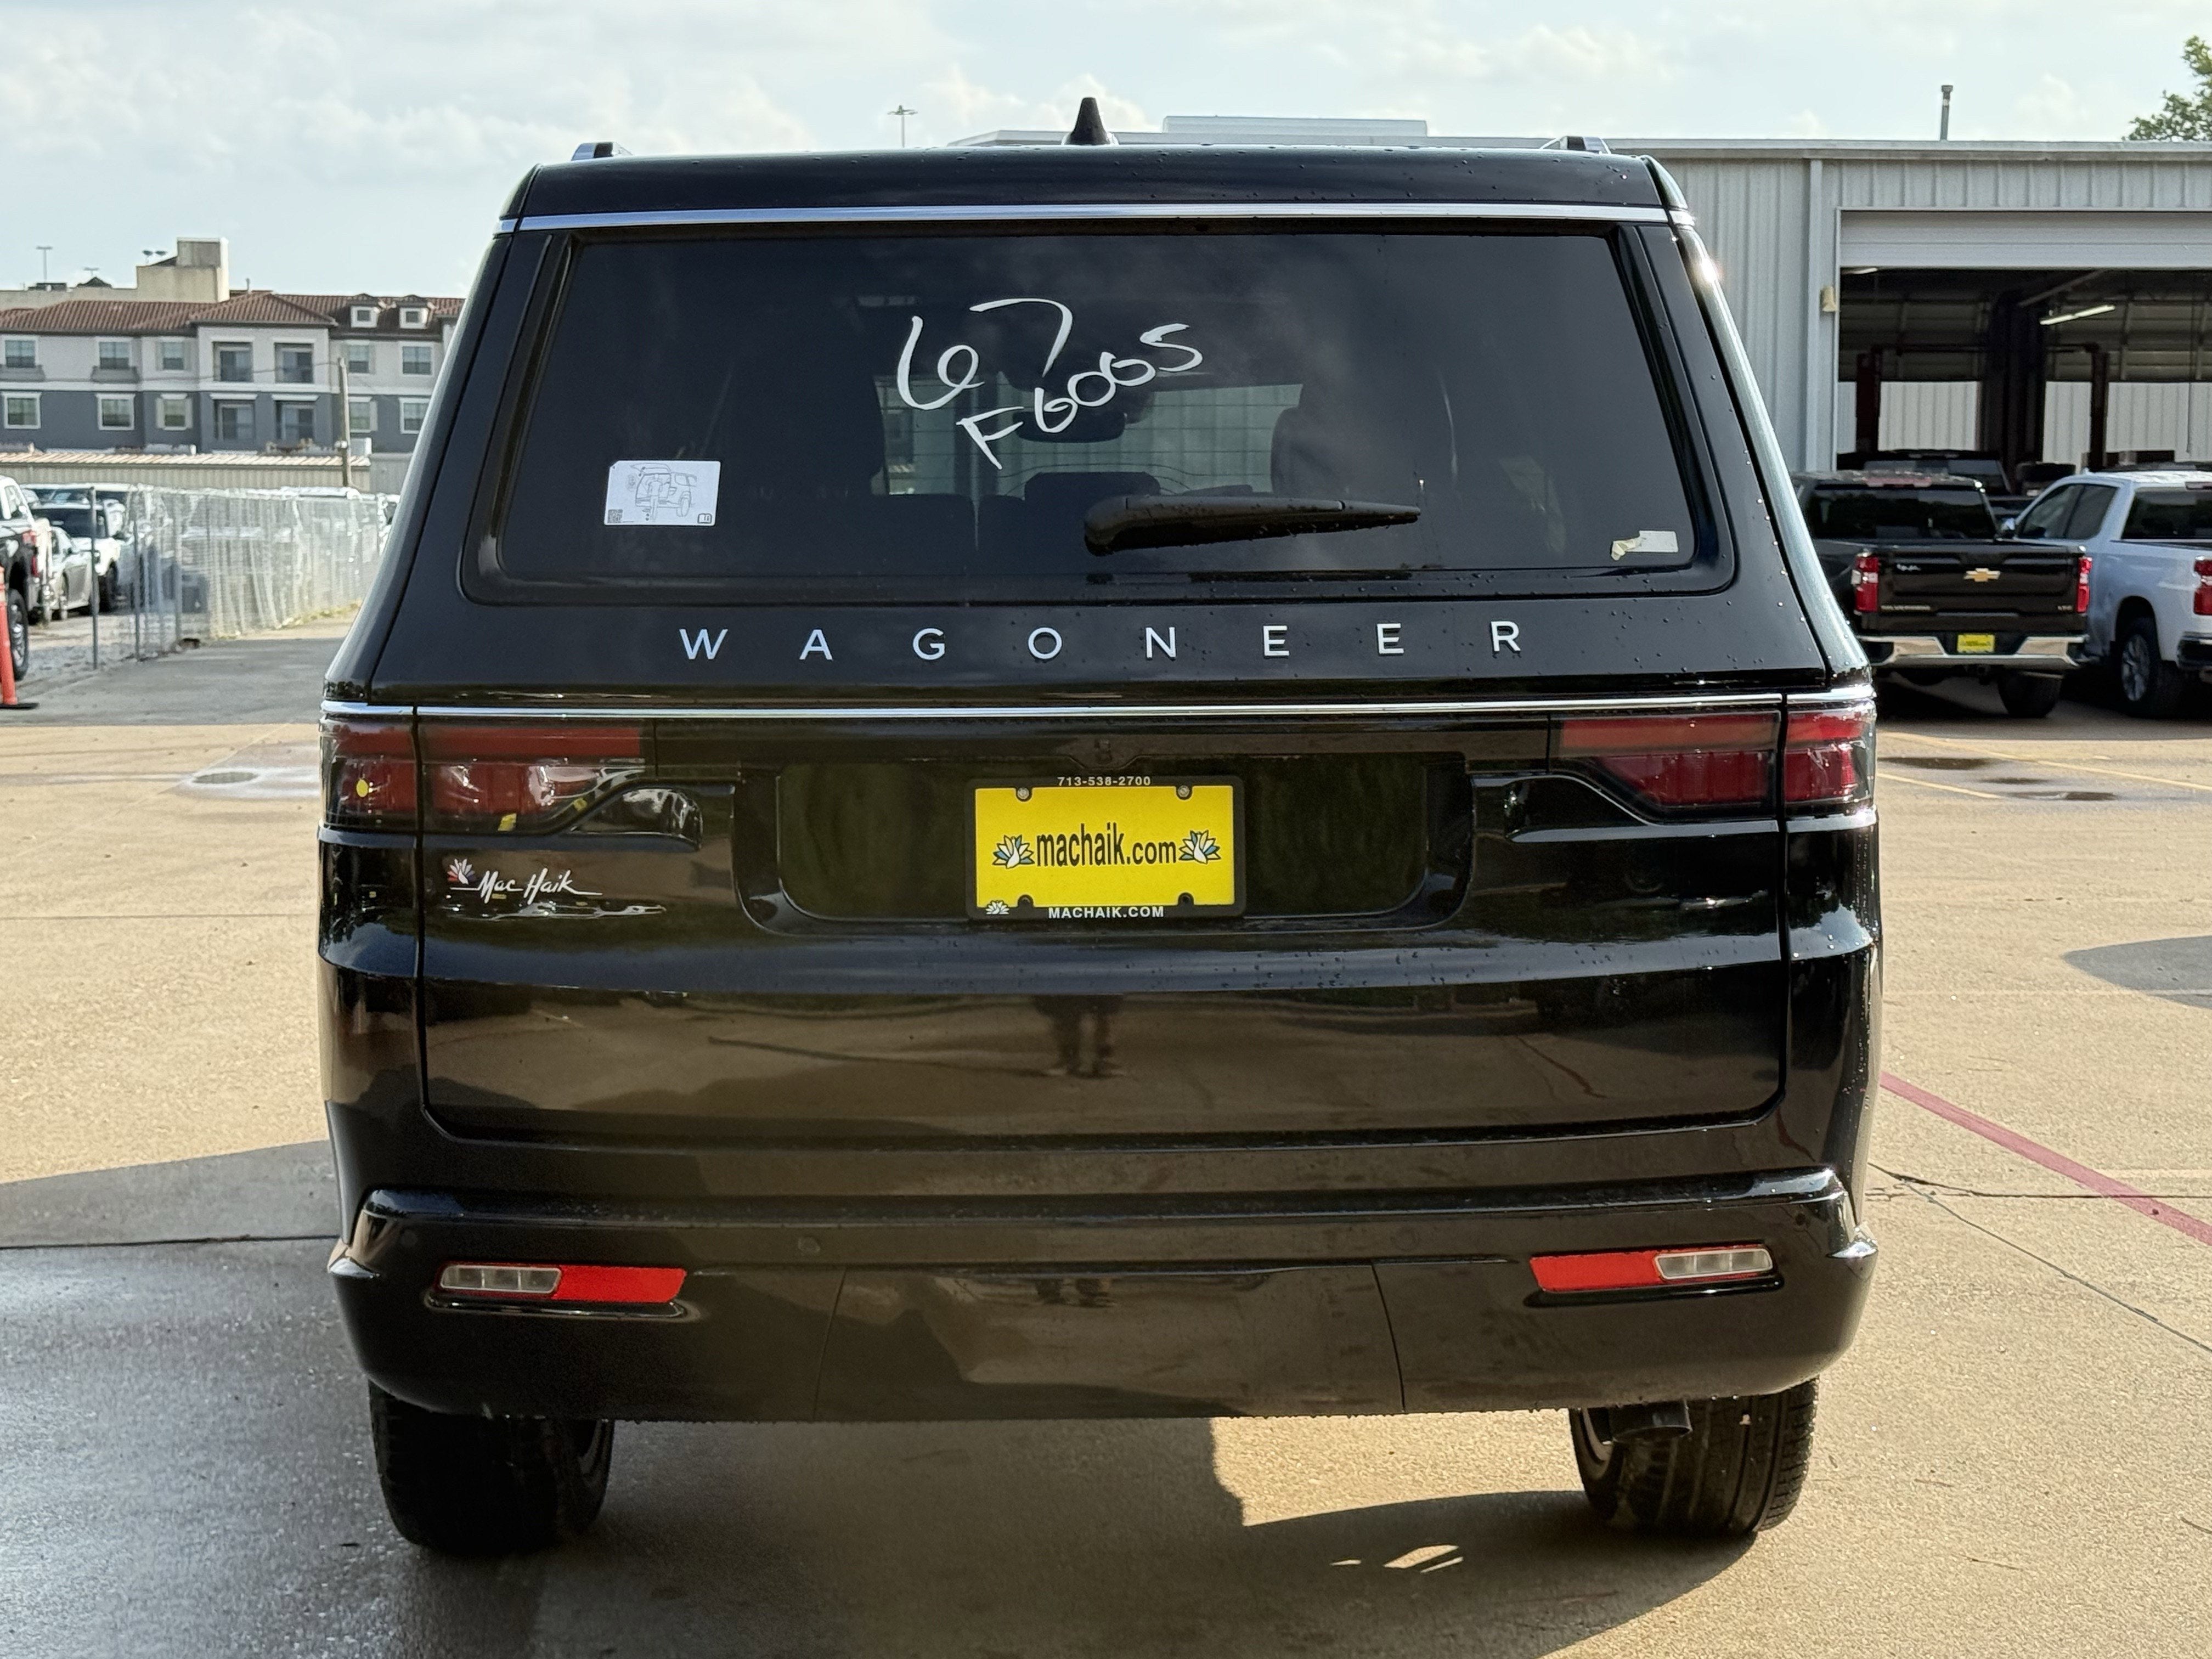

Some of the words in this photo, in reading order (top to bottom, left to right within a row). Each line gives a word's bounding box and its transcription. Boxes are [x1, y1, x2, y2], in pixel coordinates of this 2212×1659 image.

[680, 620, 1521, 660] WAGONEER
[1057, 776, 1151, 787] 713-538-2700
[1036, 822, 1177, 867] machaik.com
[472, 870, 523, 904] Mac
[523, 867, 583, 905] Haik
[1048, 906, 1164, 919] MACHAIK.COM
